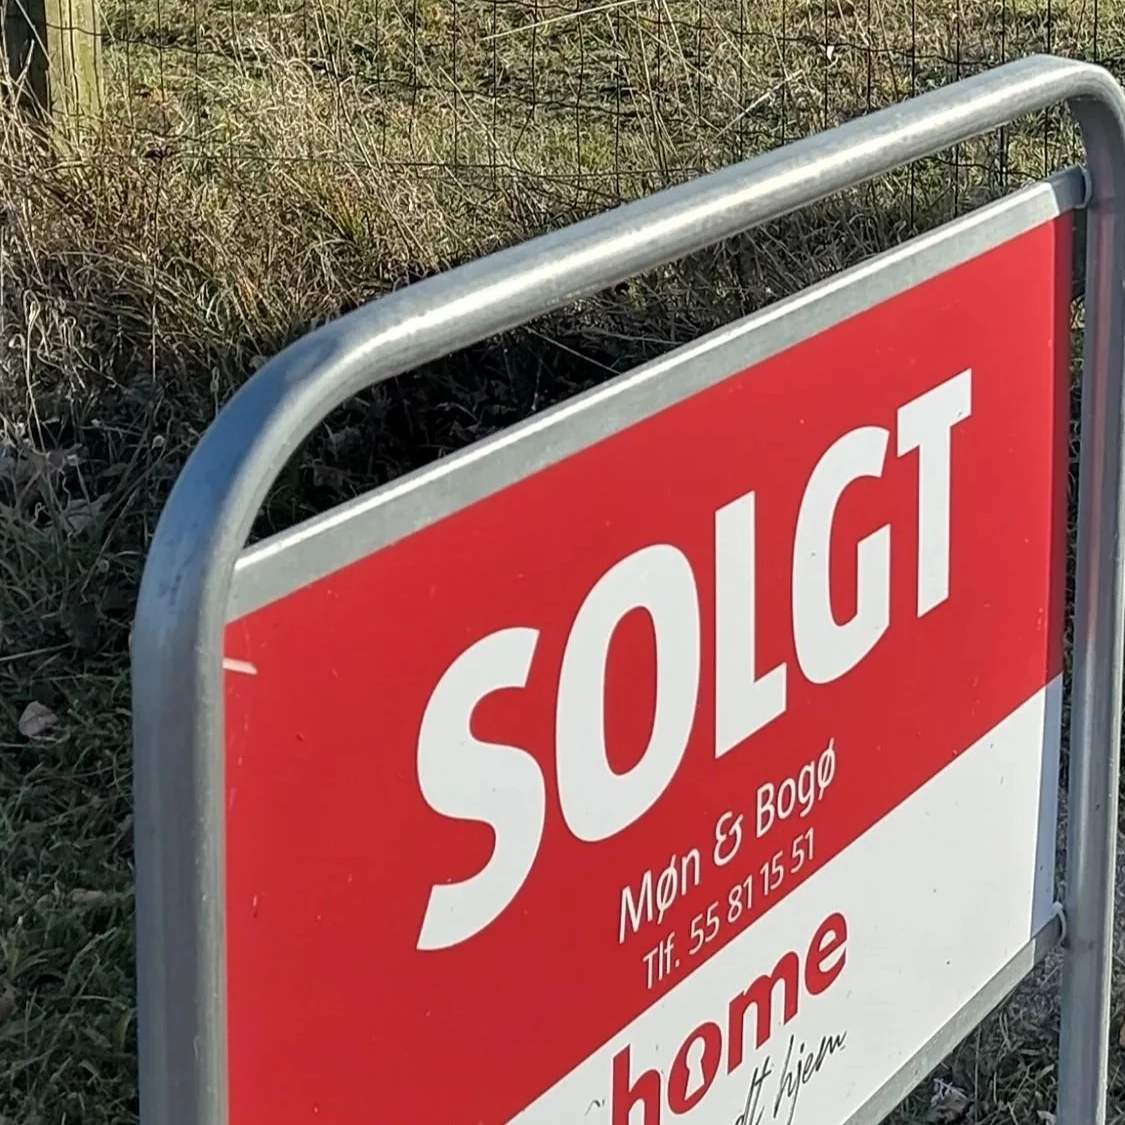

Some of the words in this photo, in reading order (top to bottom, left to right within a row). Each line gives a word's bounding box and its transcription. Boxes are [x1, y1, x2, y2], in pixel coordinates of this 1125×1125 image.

[416, 368, 973, 952] SOLGT
[618, 855, 701, 944] Møn
[713, 811, 745, 866] &
[756, 737, 837, 839] Bogø
[642, 932, 681, 989] Tlf.
[689, 901, 719, 955] 55
[727, 874, 754, 923] 81
[760, 850, 785, 895] 15
[790, 827, 814, 873] 51
[611, 911, 848, 1125] home
